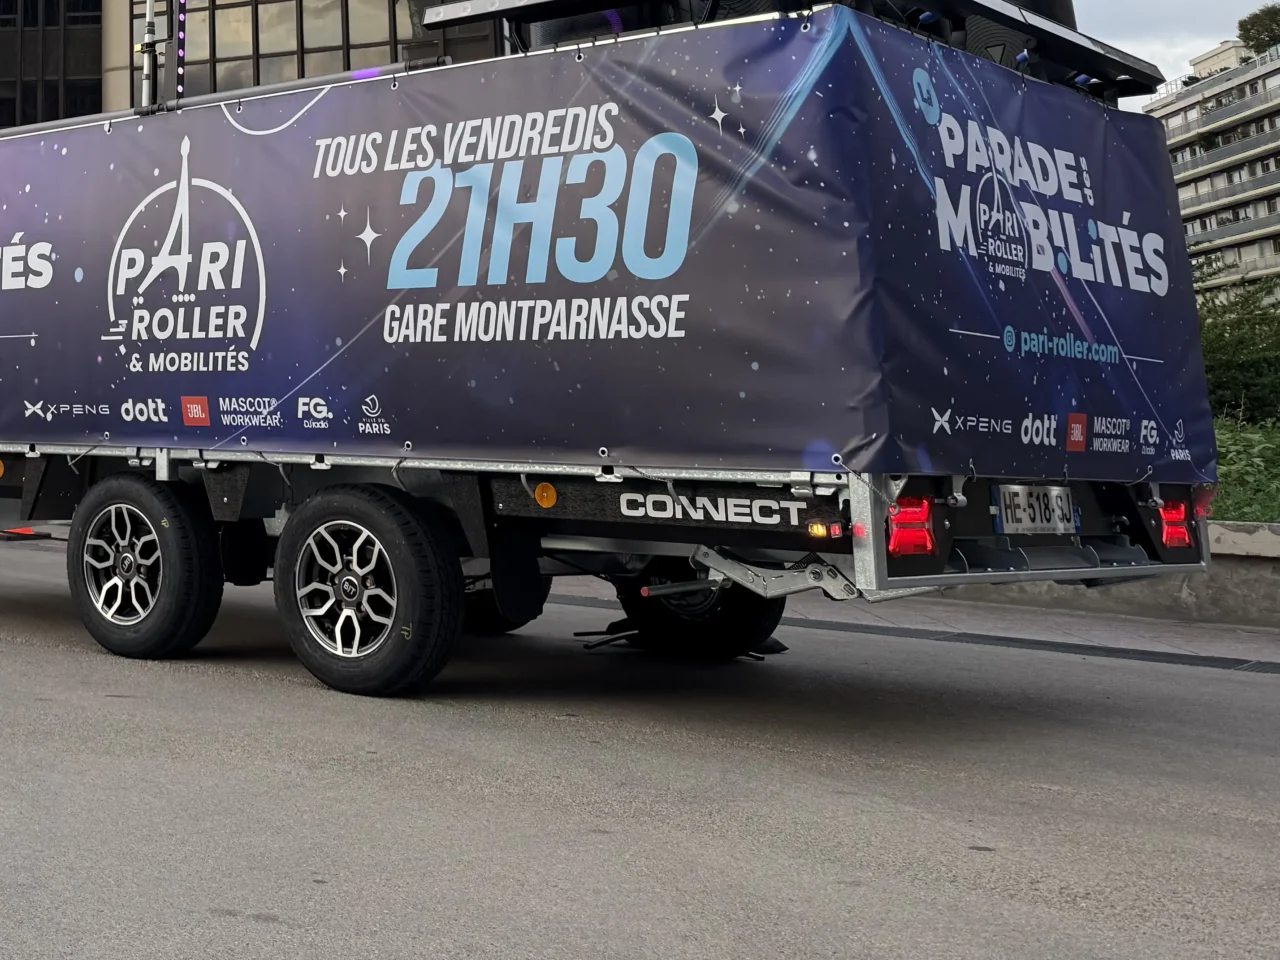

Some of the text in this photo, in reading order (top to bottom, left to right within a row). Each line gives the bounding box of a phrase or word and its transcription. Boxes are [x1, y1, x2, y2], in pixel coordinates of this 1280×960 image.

[313, 102, 619, 178] TOUS LES VENDREDIS
[938, 112, 1083, 203] PARADE
[386, 131, 699, 289] 21H30
[988, 238, 1024, 262] ROLLER
[131, 304, 248, 341] ROLLER
[383, 294, 690, 344] GARE MONTPARNASSE
[129, 345, 249, 372] & MOBILITÉS
[1020, 327, 1120, 363] pari-roller.com
[46, 403, 110, 415] XPENG
[120, 398, 168, 422] dott
[187, 404, 205, 419] JBL
[221, 414, 280, 427] WORKWEAR
[358, 423, 391, 434] PARIS
[955, 416, 1012, 433] XPENG
[1021, 412, 1057, 446] dott
[1093, 437, 1129, 453] WORKWEAR
[1170, 448, 1191, 460] PARIS
[620, 492, 807, 526] CONNECT
[1002, 491, 1072, 524] HE-518-SJ
